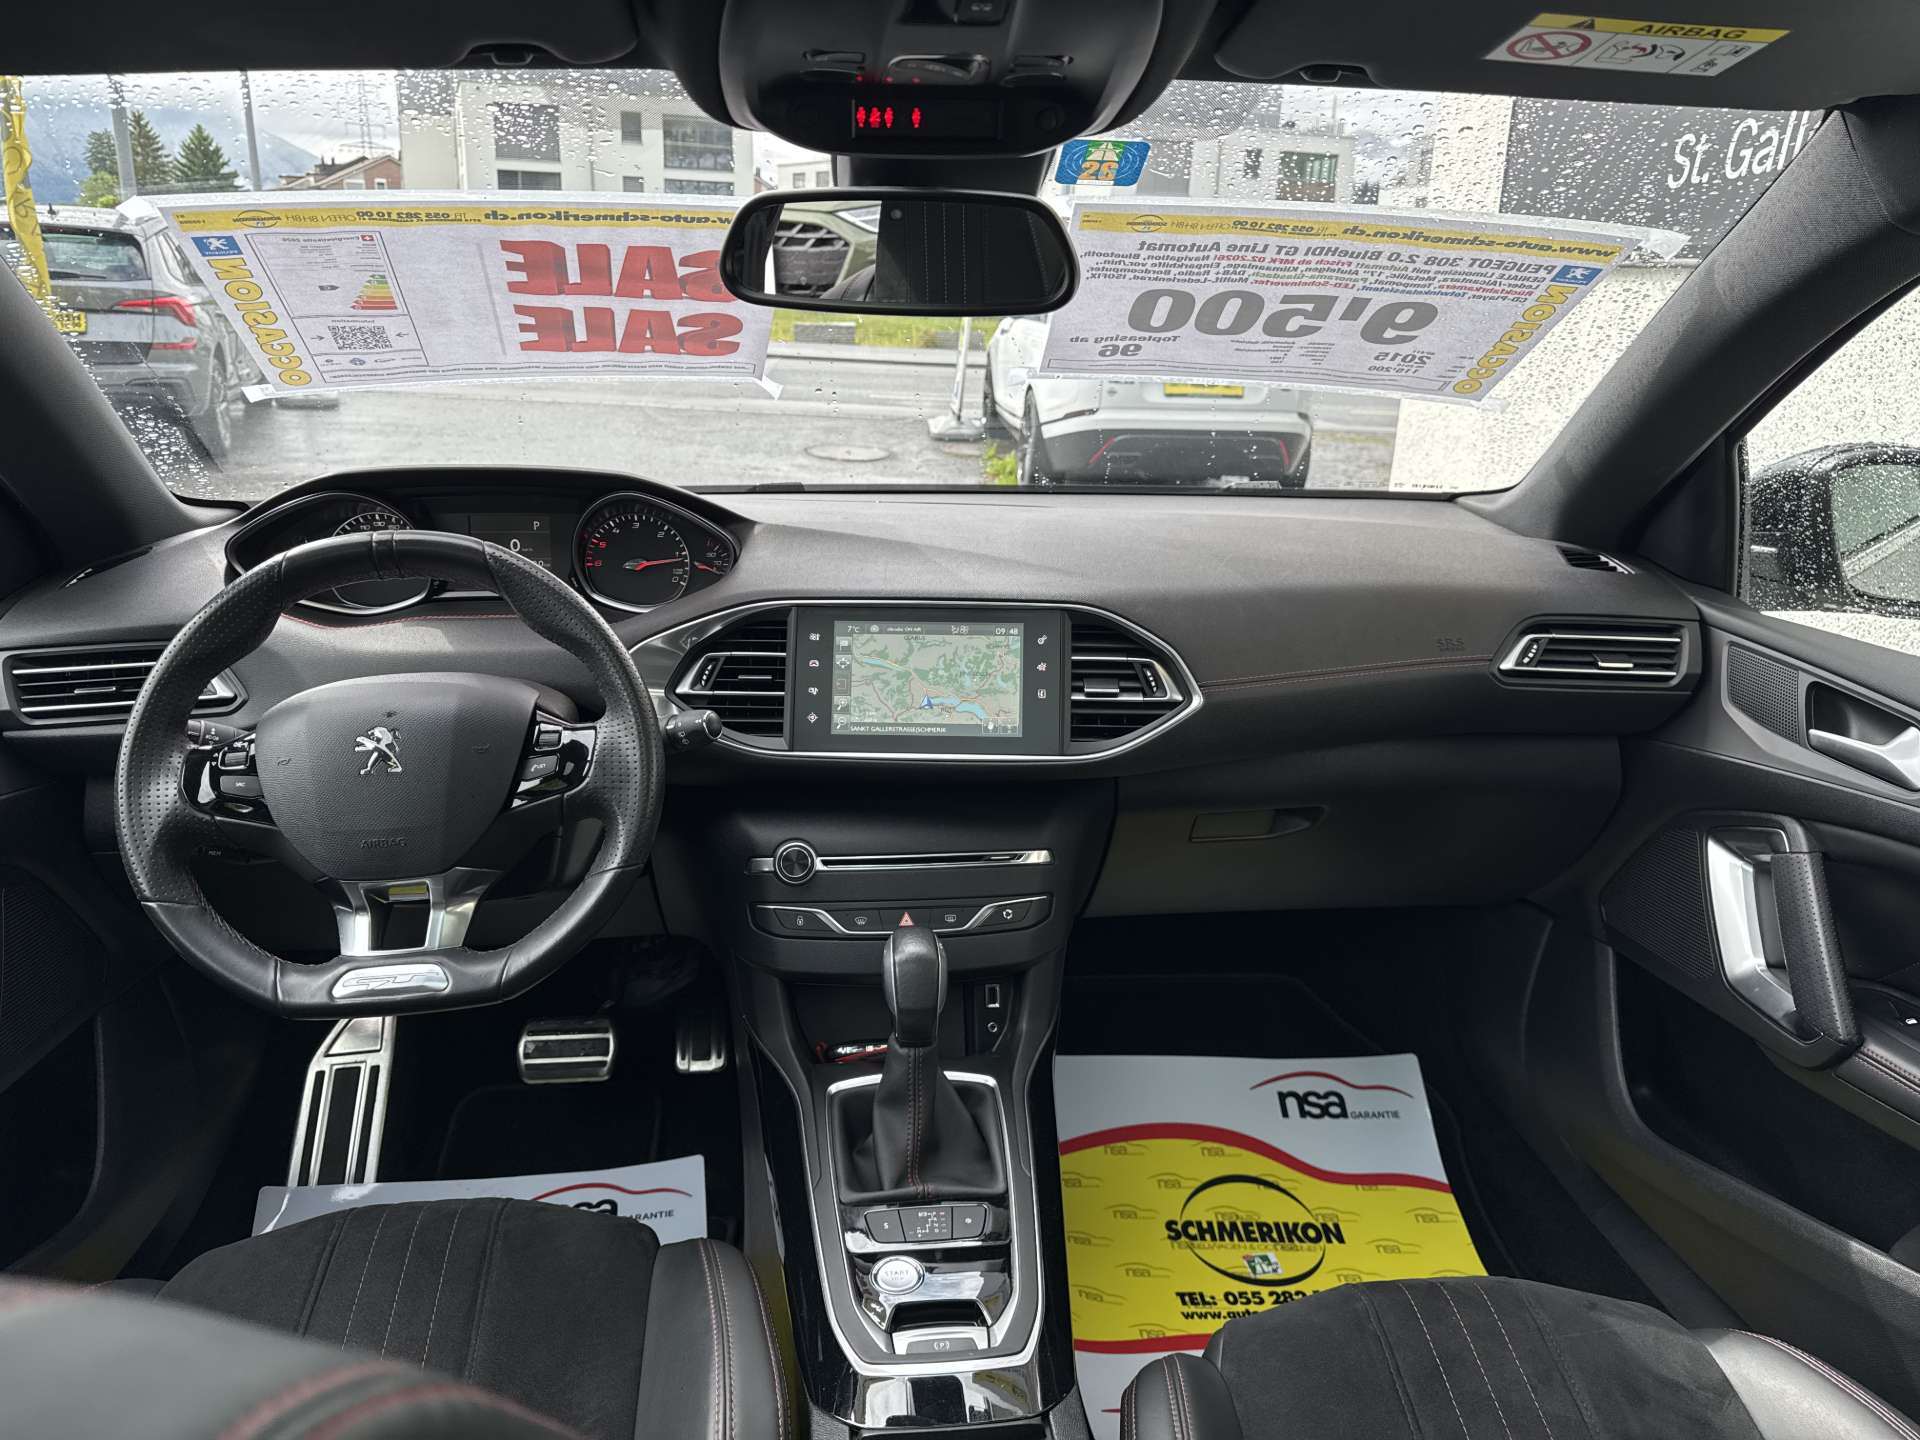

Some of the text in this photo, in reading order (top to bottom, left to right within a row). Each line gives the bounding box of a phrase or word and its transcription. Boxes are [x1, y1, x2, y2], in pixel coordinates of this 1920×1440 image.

[1632, 23, 1747, 40] AIRBAG
[1666, 132, 1710, 190] St.
[533, 520, 540, 531] P
[509, 538, 521, 552] 0
[599, 541, 608, 549] 5
[360, 837, 408, 849] AIRBAG
[1276, 1089, 1400, 1120] nsa GARANTIE
[1157, 1178, 1182, 1189] nsa
[627, 1209, 675, 1221] ARANTIE
[1112, 1209, 1138, 1220] nsa
[1414, 1213, 1440, 1224] nsa
[1164, 1219, 1347, 1245] SCHMERIKON
[1375, 1244, 1401, 1255] nsa
[1125, 1267, 1151, 1278] nsa
[1175, 1291, 1219, 1307] TEL:
[1222, 1290, 1266, 1306] 055
